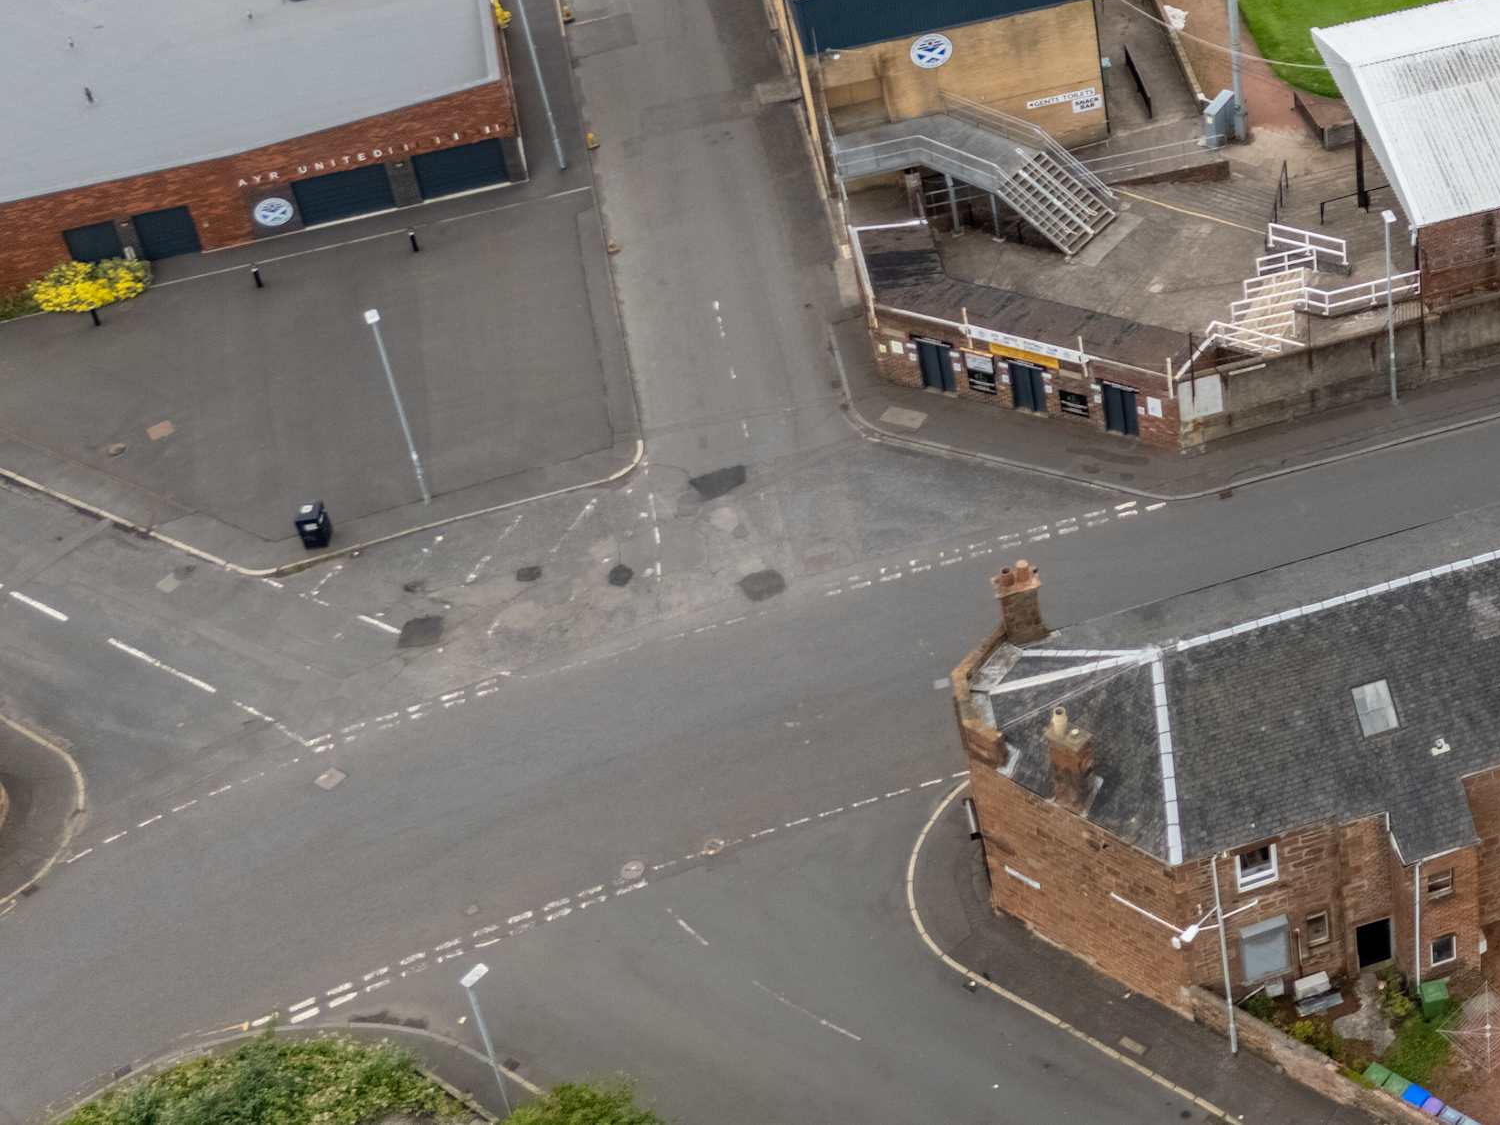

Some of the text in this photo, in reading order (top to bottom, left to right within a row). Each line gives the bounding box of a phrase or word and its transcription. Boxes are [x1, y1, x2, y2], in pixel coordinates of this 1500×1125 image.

[1034, 97, 1060, 107] GENTS
[238, 149, 383, 188] AYR UNITED
